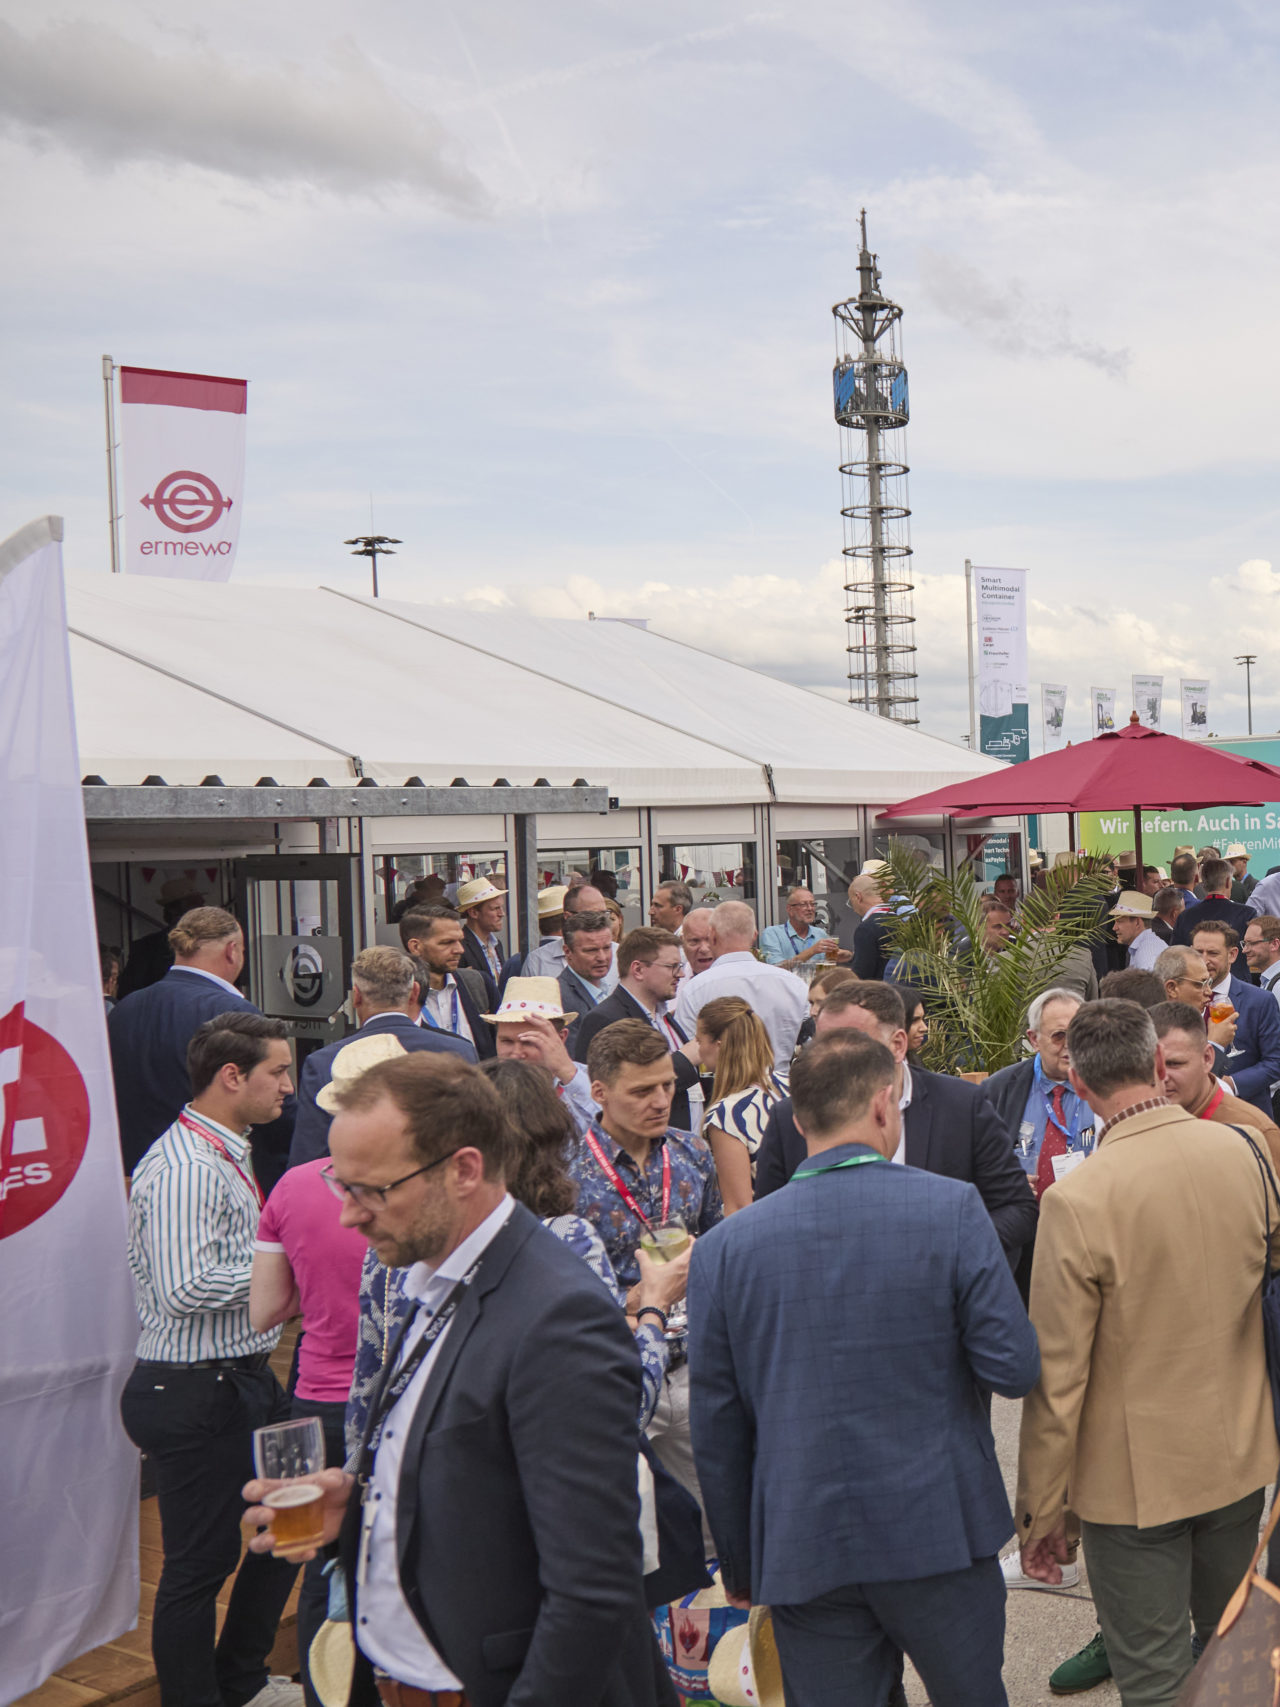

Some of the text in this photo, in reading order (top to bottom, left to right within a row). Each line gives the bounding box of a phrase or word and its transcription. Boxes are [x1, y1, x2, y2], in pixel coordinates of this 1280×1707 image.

[140, 541, 232, 556] ermewa
[1100, 818, 1129, 834] Wir
[1141, 816, 1193, 833] iefern.
[1197, 814, 1240, 832] Auch
[1245, 812, 1260, 829] in
